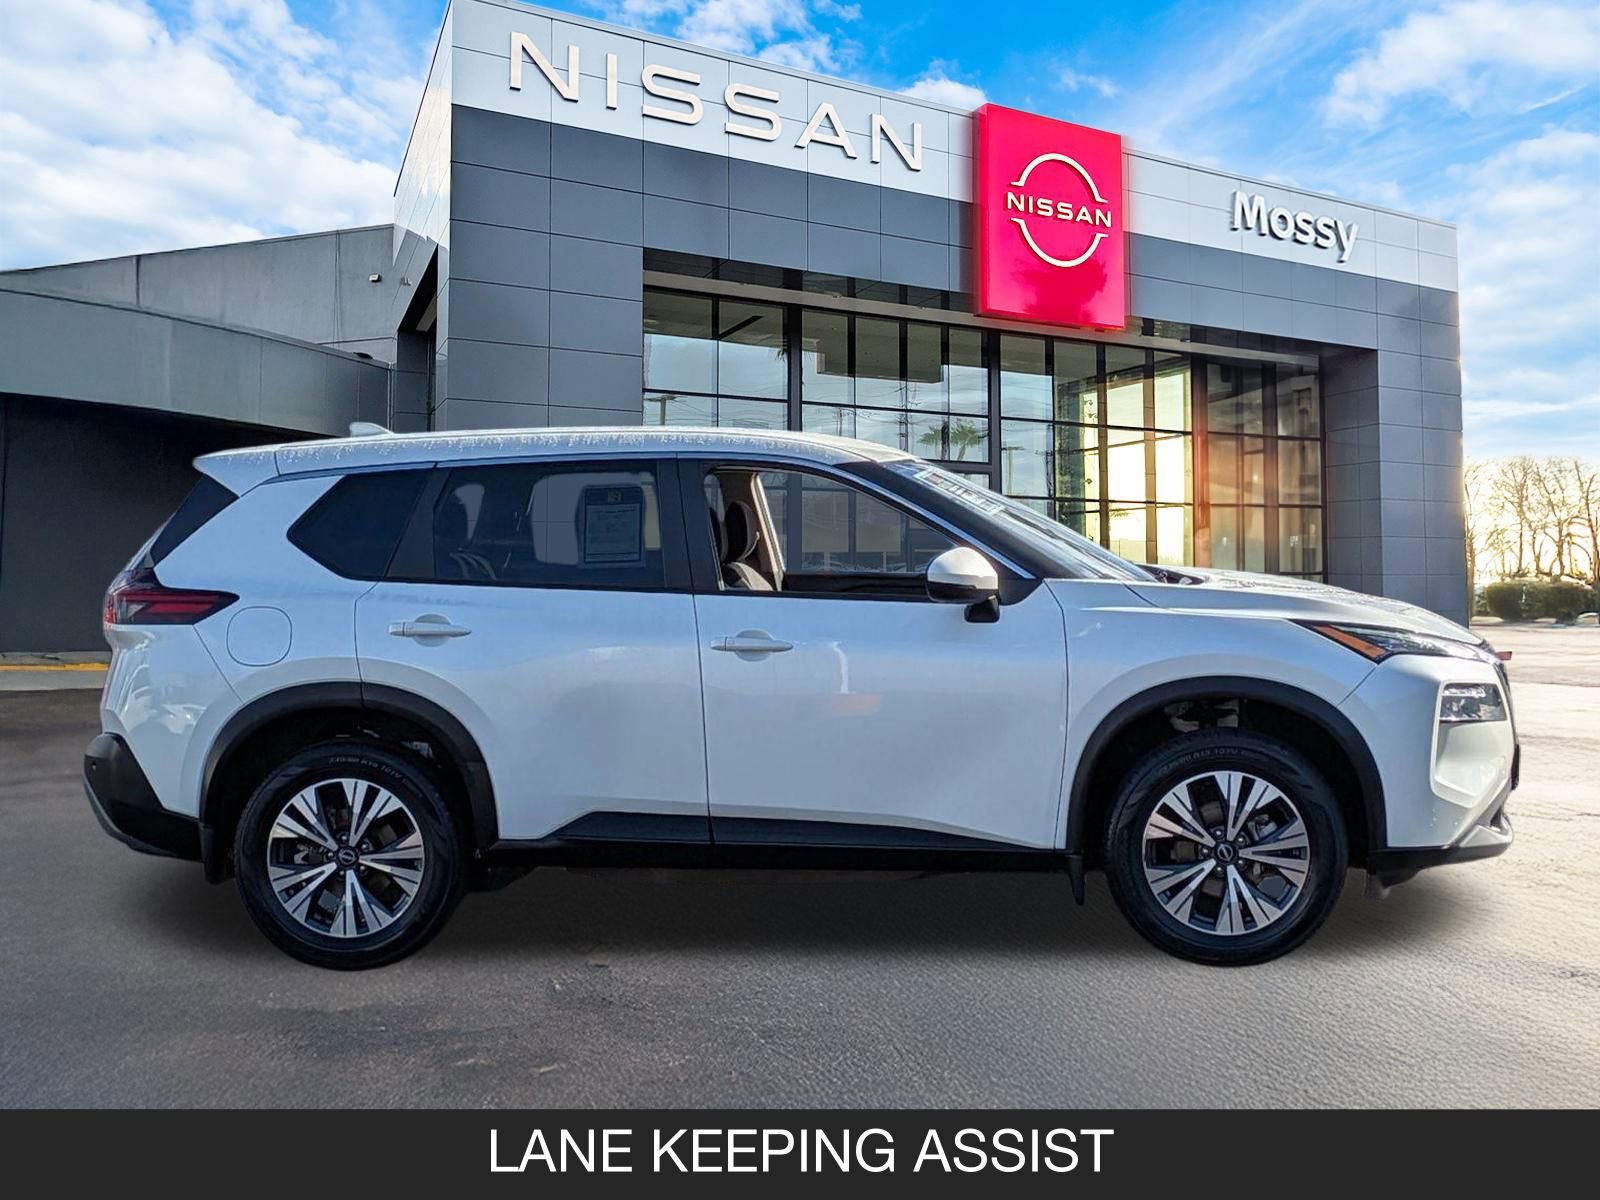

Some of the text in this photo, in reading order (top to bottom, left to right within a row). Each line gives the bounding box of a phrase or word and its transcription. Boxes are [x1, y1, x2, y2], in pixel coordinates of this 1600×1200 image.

[509, 31, 922, 171] NISSAN
[1007, 191, 1112, 228] NISSAN
[1230, 190, 1359, 262] Mossy
